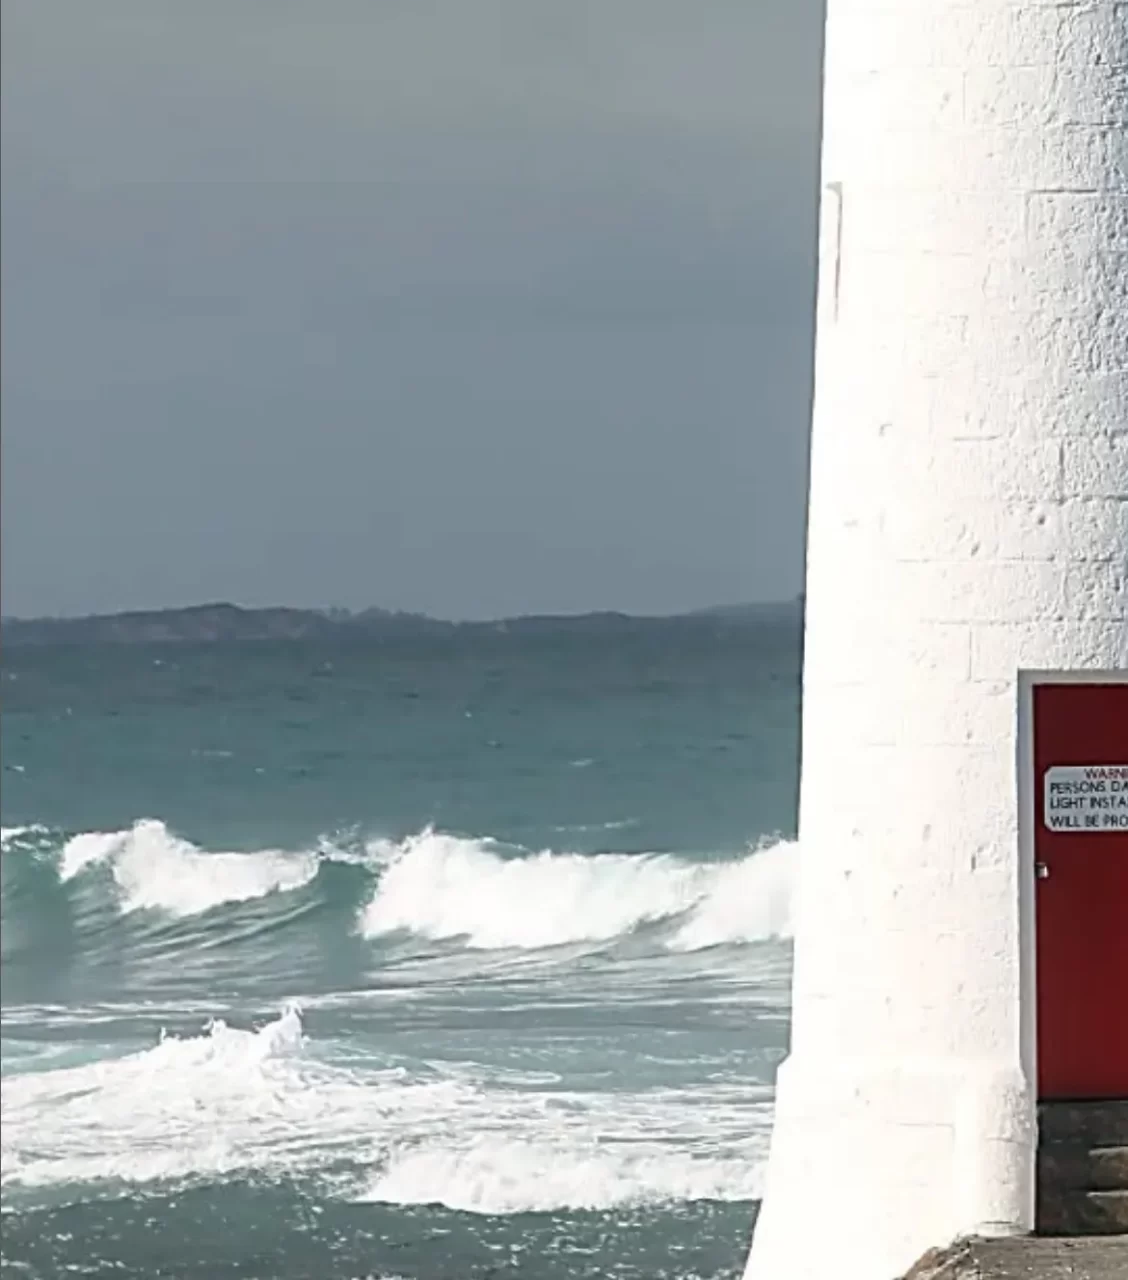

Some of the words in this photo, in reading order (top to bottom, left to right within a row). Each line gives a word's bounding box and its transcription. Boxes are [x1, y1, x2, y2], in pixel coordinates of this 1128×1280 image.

[1050, 781, 1106, 794] PERSONS
[1050, 797, 1086, 809] LIGHT
[1050, 815, 1081, 828] WILL
[1085, 815, 1099, 827] BE
